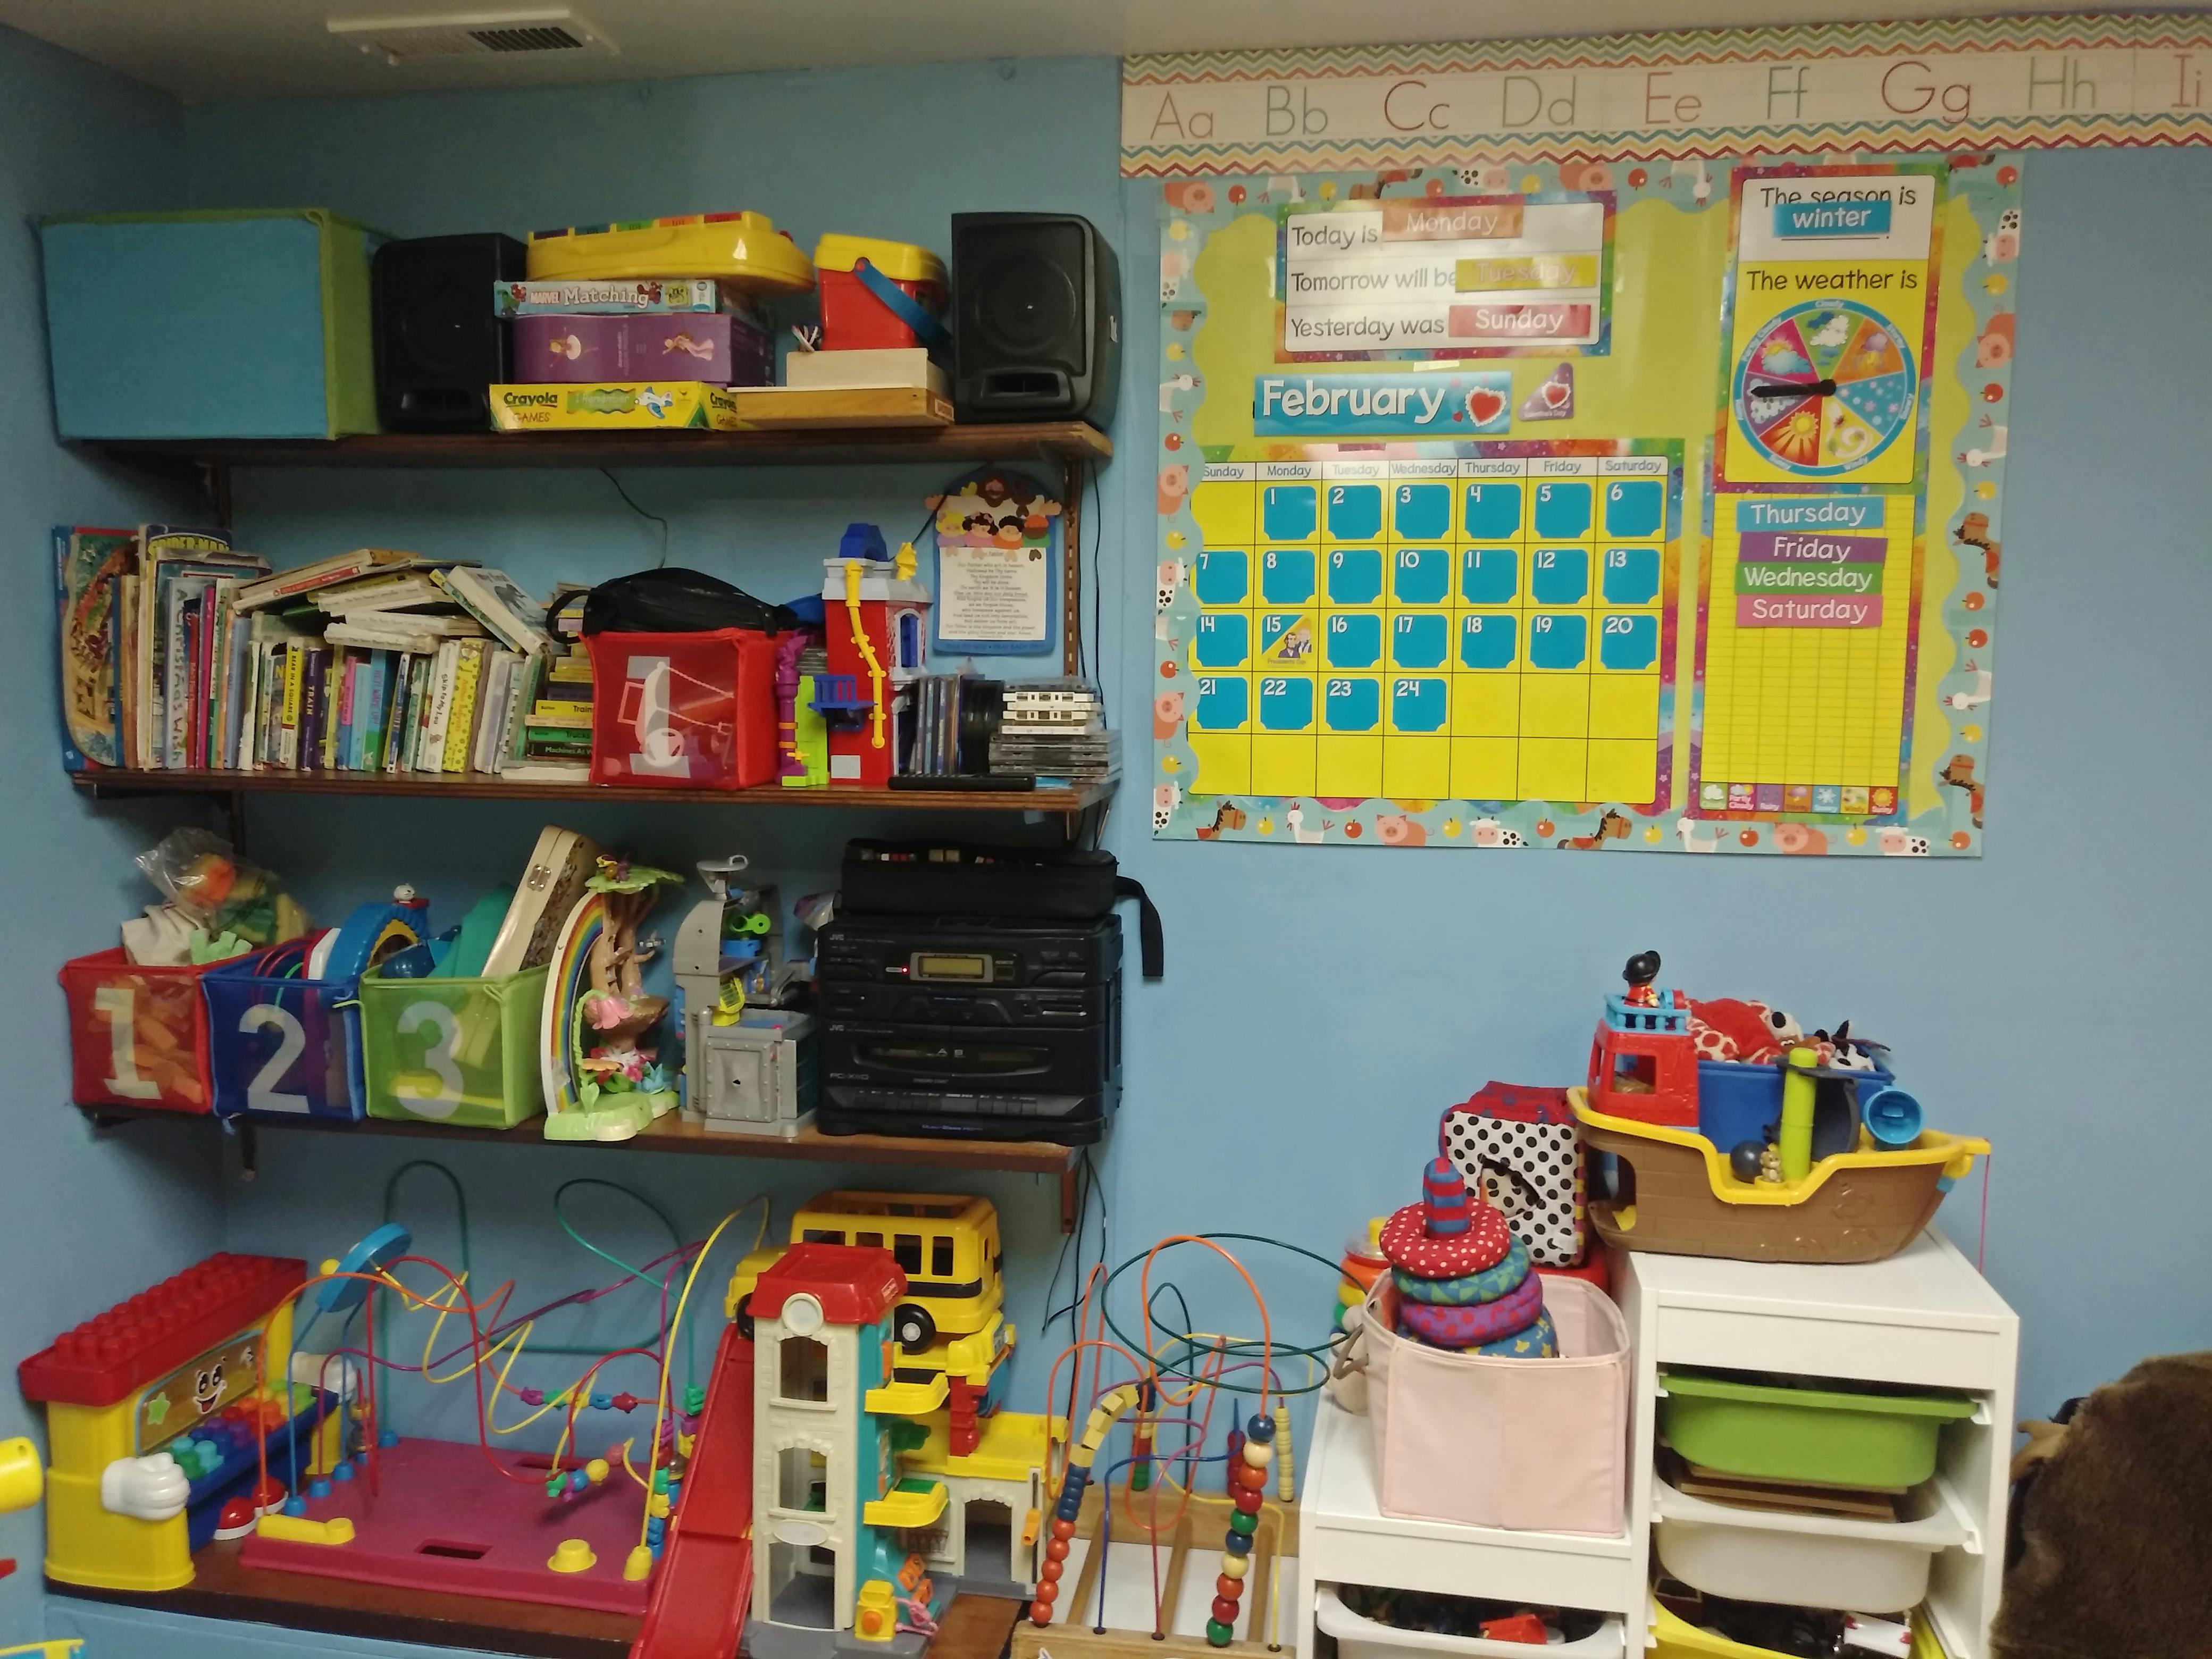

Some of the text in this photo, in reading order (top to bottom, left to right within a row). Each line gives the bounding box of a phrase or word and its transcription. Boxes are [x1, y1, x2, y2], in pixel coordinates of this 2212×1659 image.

[1151, 91, 1213, 139] Aa
[1266, 85, 1329, 136] Bb
[1384, 80, 1450, 131] Cc
[1502, 75, 1575, 128] Dd
[1644, 71, 1701, 124] Ee
[1766, 66, 1809, 119] Ff
[1881, 61, 1971, 124] Gg
[2028, 55, 2096, 110] Hh
[1760, 186, 1916, 208] The season is
[1292, 212, 1498, 249] Today is Monday
[1792, 208, 1872, 229] winter
[1291, 262, 1576, 292] Tomorrow will be Tuesday
[1746, 270, 1918, 290] The weather is
[531, 284, 649, 309] MARVEL Matching
[1291, 310, 1564, 341] Yesterday was Sunday
[504, 391, 558, 407] Crayola
[1263, 380, 1445, 425] February
[514, 412, 551, 422] GAMES
[1203, 460, 1662, 479] Sunday Monday Tuesday Wednesday Thursday Friday Saturday
[1270, 484, 1623, 505] 1 2 3 4 5 6
[1750, 501, 1866, 526] Thursday
[1199, 550, 1627, 570] 7 8 9 10 11 12 13
[1773, 536, 1851, 564] Friday
[1743, 566, 1873, 593] Wednesday
[1752, 598, 1869, 624] Saturday
[1200, 616, 1633, 634] 14 15 16 17 18 19 20
[1200, 678, 1420, 697] 21 22 23 24
[94, 986, 464, 1119] 1 2 3
